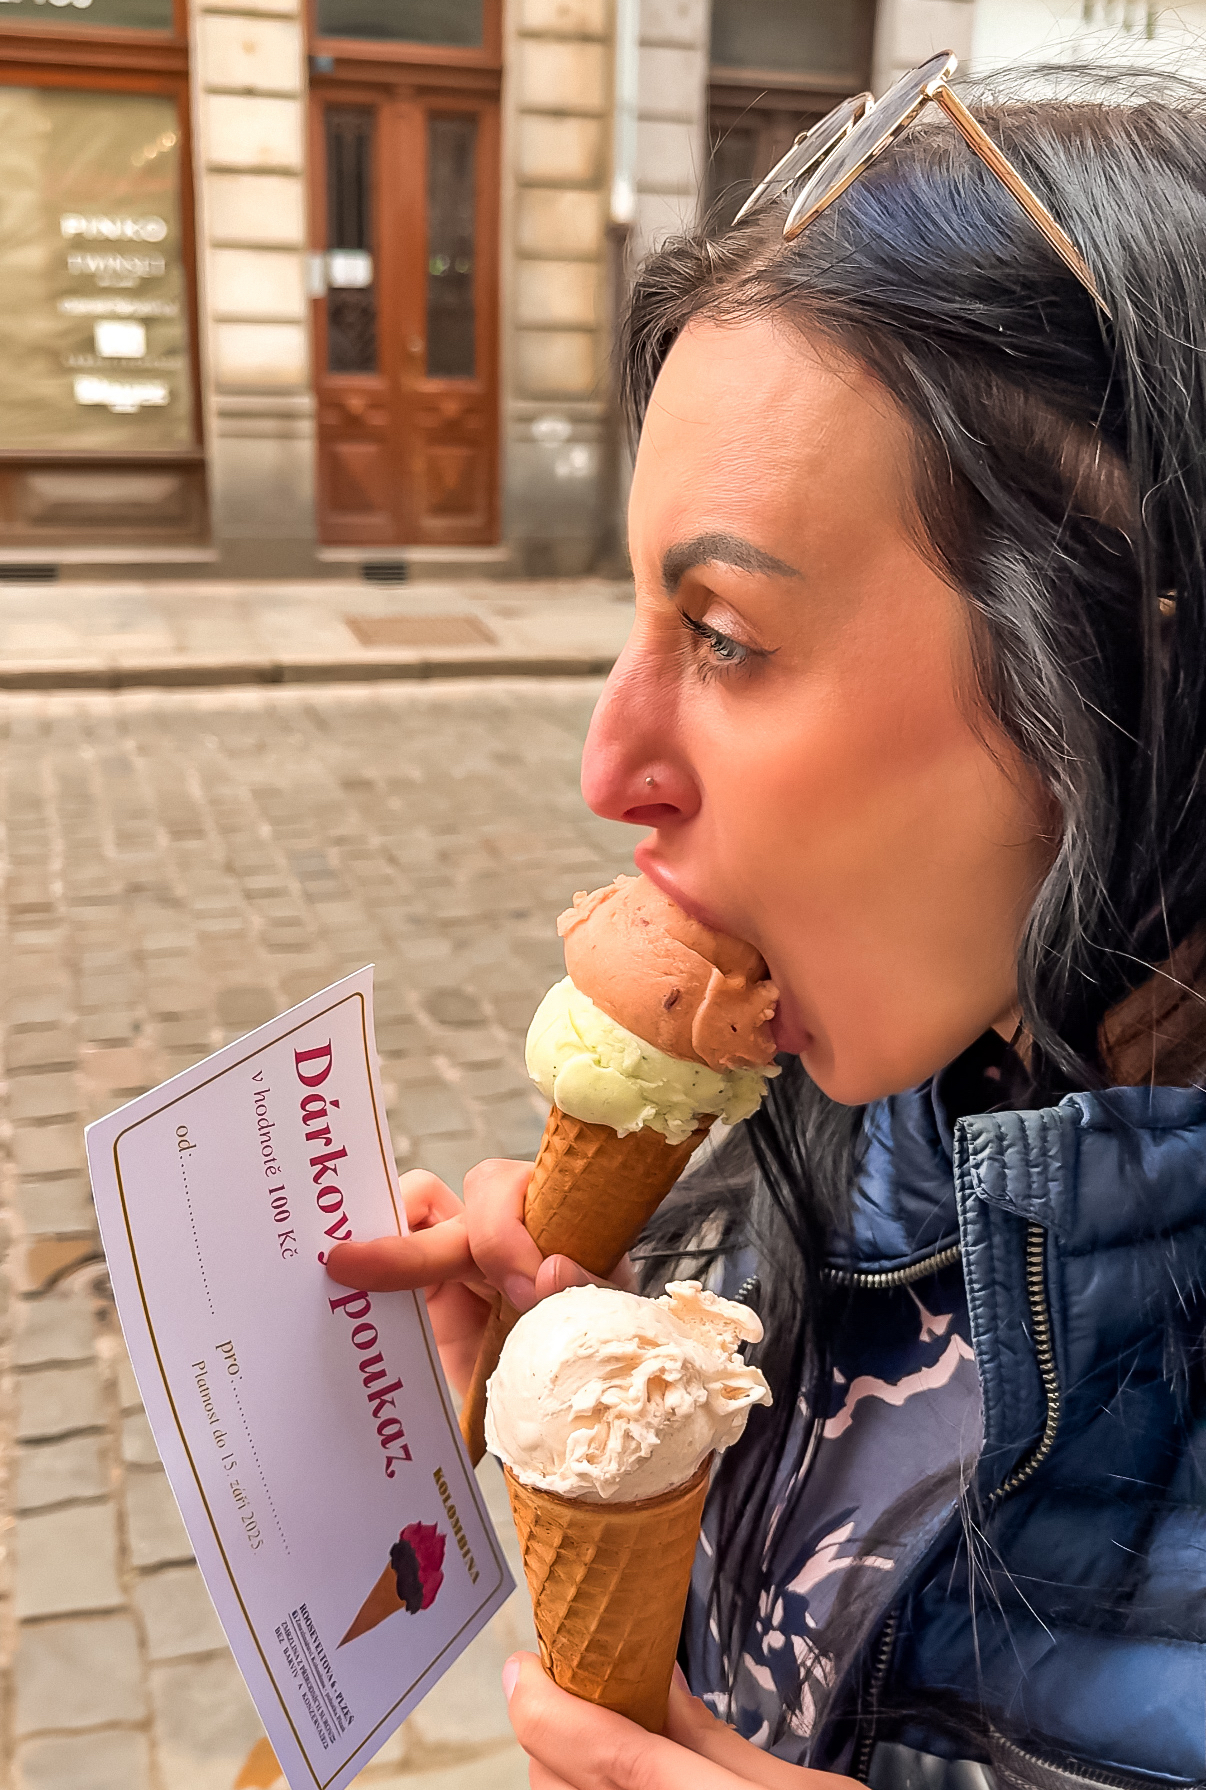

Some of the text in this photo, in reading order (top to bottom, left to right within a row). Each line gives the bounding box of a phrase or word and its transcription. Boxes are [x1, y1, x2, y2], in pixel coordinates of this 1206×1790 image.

[251, 1070, 299, 1260] v hodnotě 100 Kč
[191, 1360, 220, 1425] Platnost
[328, 1290, 414, 1479] poukaz
[212, 1429, 228, 1449] do
[221, 1452, 238, 1477] 15.
[229, 1479, 250, 1510] září
[432, 1466, 480, 1585] KOLOMBINA
[274, 1626, 285, 1645] BEZ
[282, 1646, 299, 1678] BARVIV
[299, 1602, 336, 1685] ROOSEVELTOVA
[335, 1691, 355, 1726] PLZEŇ
[318, 1709, 337, 1744] SUROV
